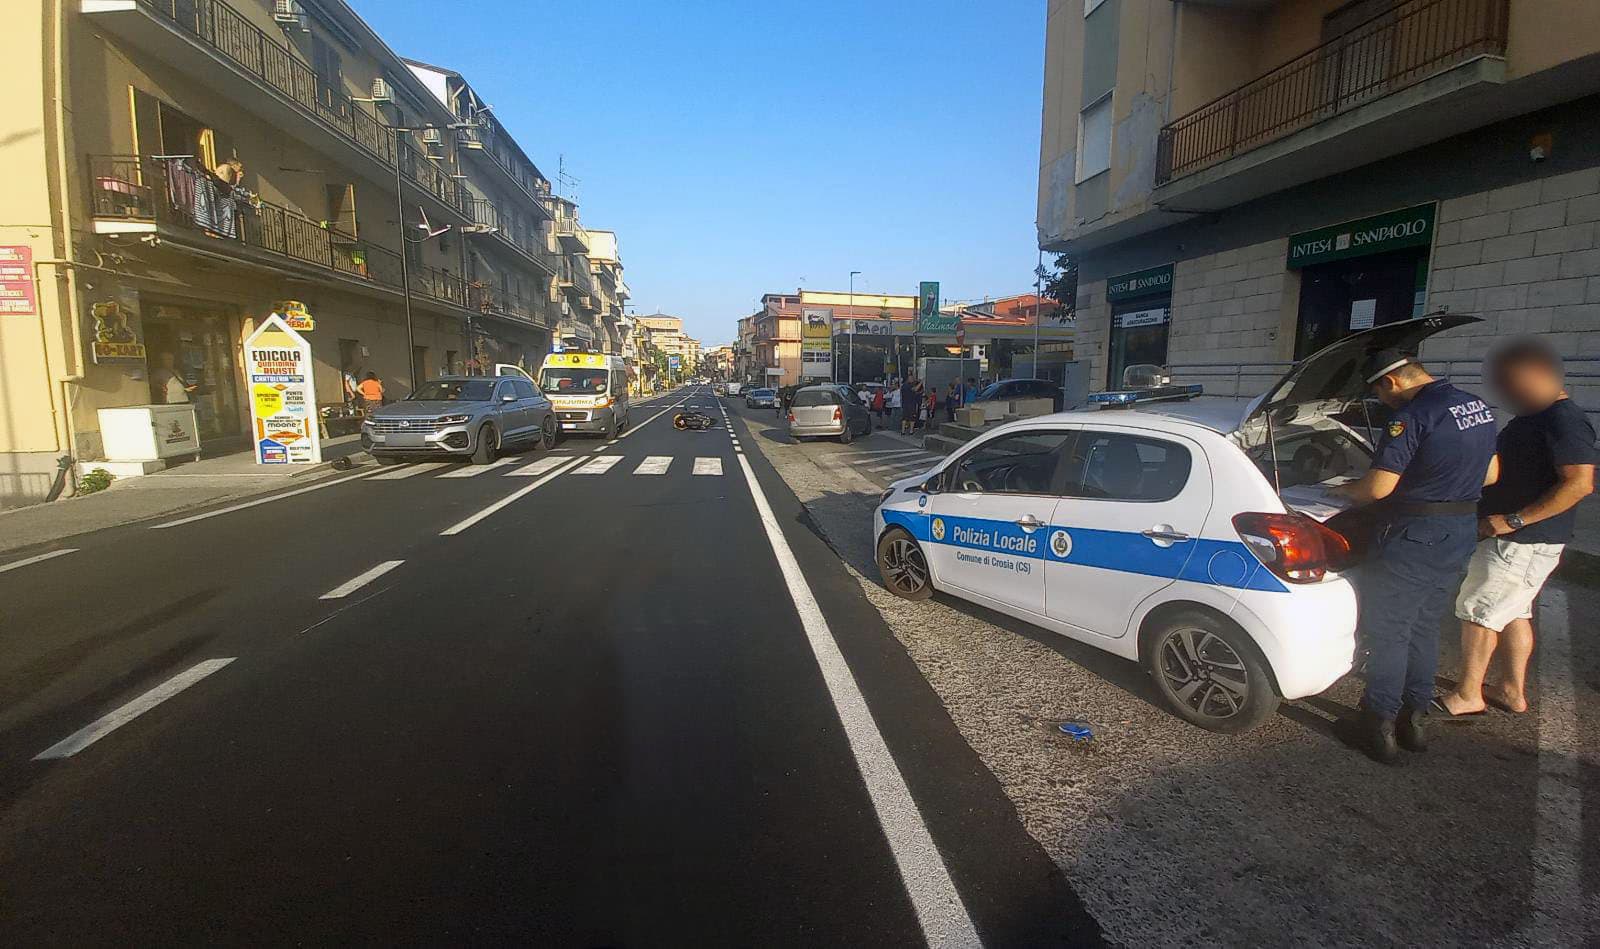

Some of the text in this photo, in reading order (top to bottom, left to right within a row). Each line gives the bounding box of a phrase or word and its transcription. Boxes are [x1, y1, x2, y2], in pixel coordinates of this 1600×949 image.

[1293, 219, 1426, 258] INTESA SANPAOLO
[1138, 273, 1170, 287] SANPAOLO
[871, 322, 893, 334] eni
[252, 351, 301, 361] EDICOLA
[1448, 399, 1488, 418] POLIZIA
[1455, 410, 1494, 431] LOCALE
[953, 526, 1037, 553] Polizia Locale
[956, 551, 1031, 575] Comune di Crosia (CS)
